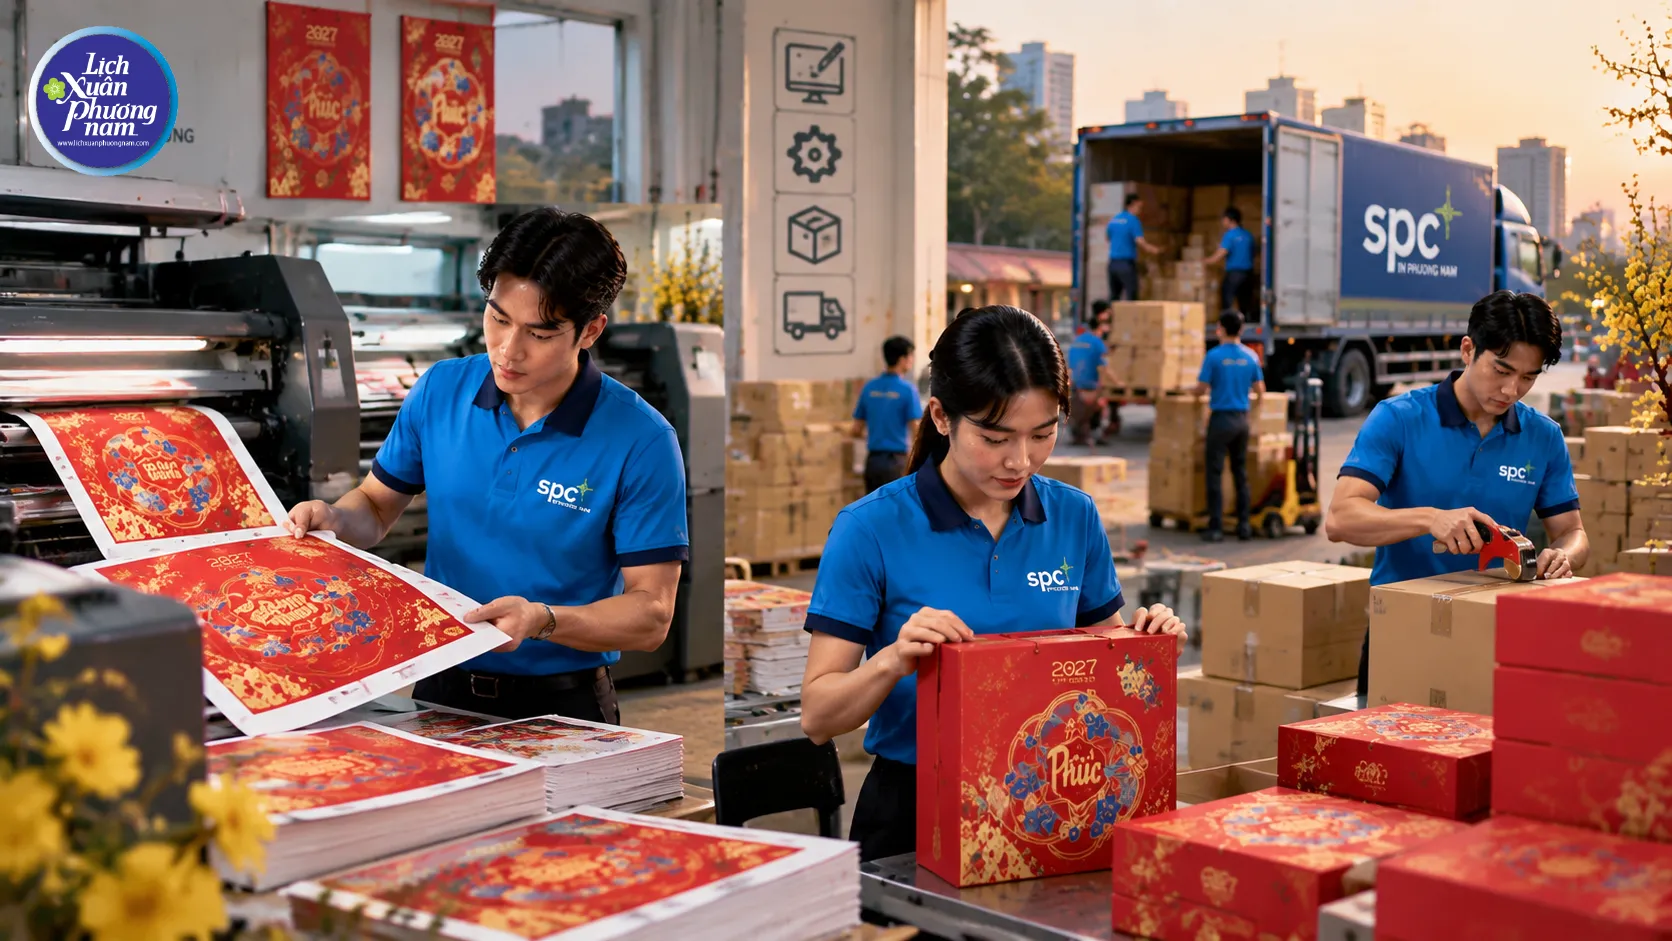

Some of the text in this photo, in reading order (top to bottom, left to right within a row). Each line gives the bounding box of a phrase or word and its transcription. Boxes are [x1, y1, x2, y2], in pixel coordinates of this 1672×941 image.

[306, 25, 338, 41] 2027
[1362, 204, 1441, 273] spc
[1498, 465, 1527, 482] spc
[536, 479, 579, 503] spc
[1026, 569, 1065, 593] spc
[1051, 658, 1098, 677] 2027
